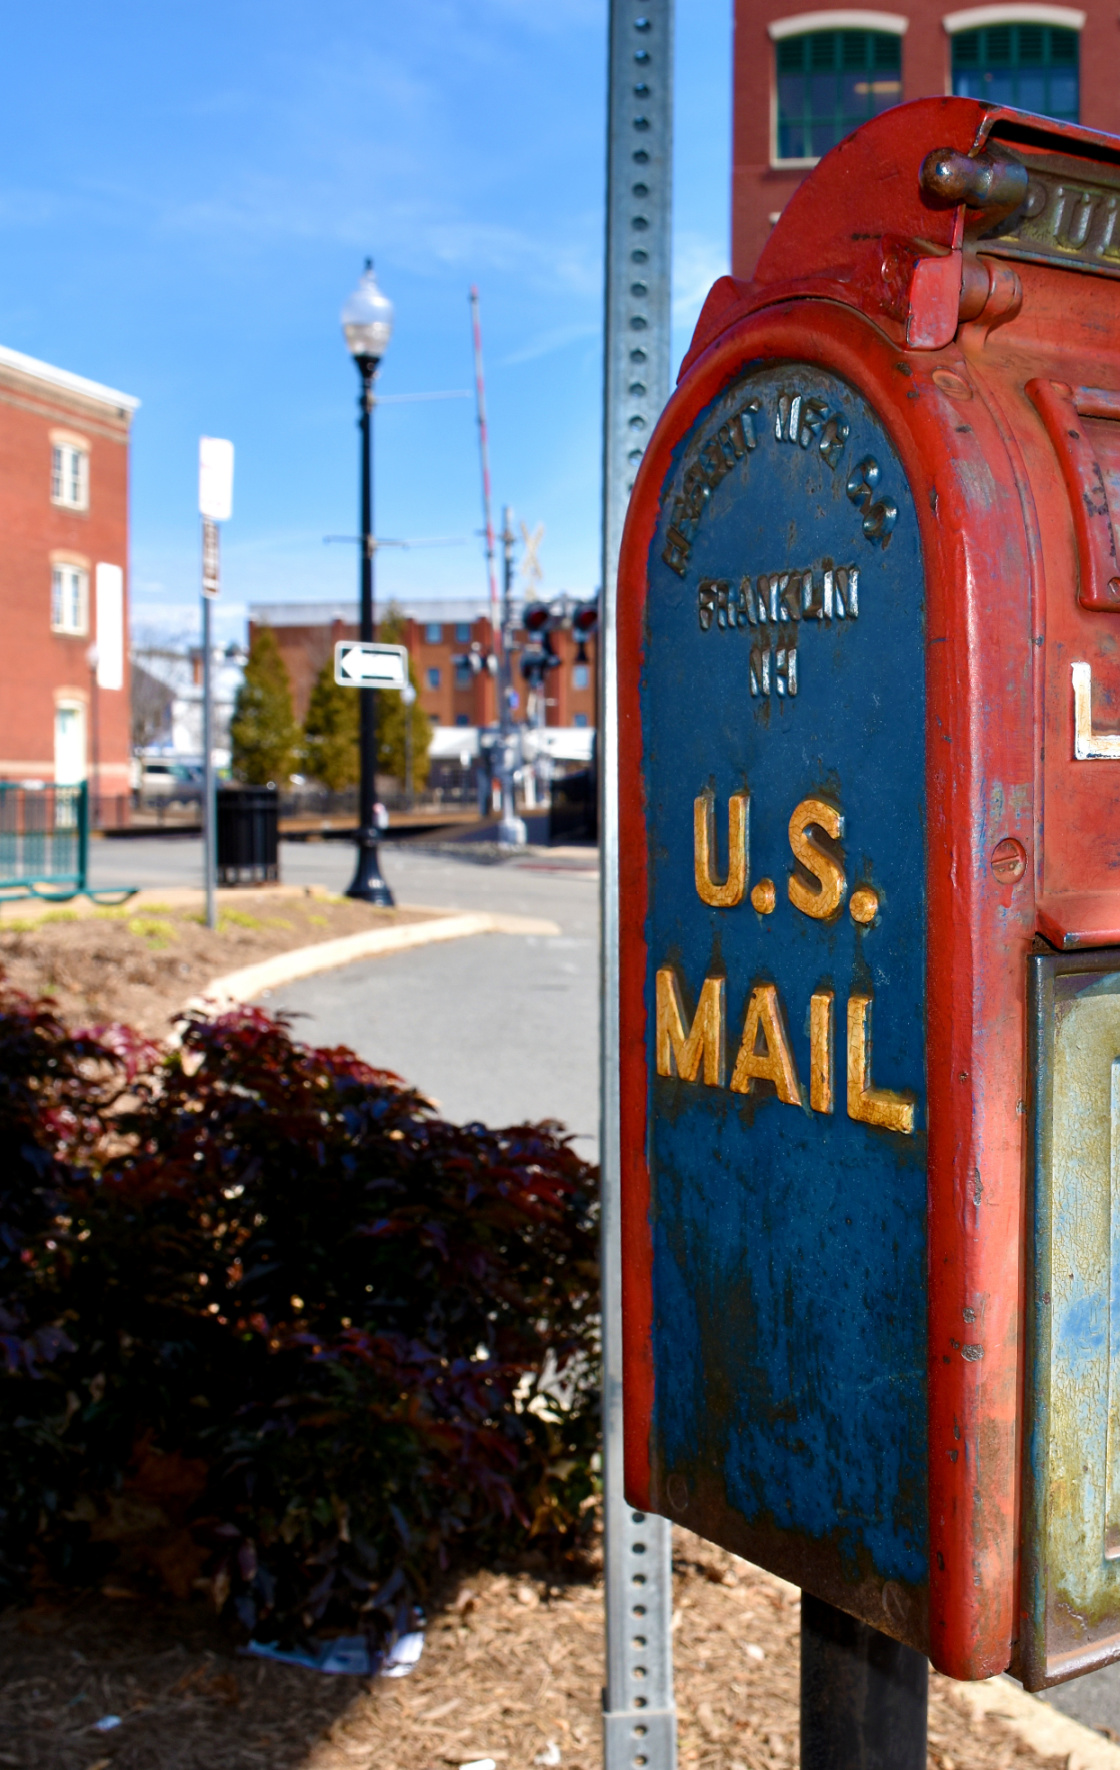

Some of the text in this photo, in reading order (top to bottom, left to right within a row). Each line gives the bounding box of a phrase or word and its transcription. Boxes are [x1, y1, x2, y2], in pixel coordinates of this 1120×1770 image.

[775, 396, 850, 471] MFG
[847, 454, 898, 547] CO
[699, 566, 860, 630] FRANKLIN
[750, 648, 798, 698] NH
[693, 793, 879, 924] U.S.
[655, 965, 915, 1136] MAIL
